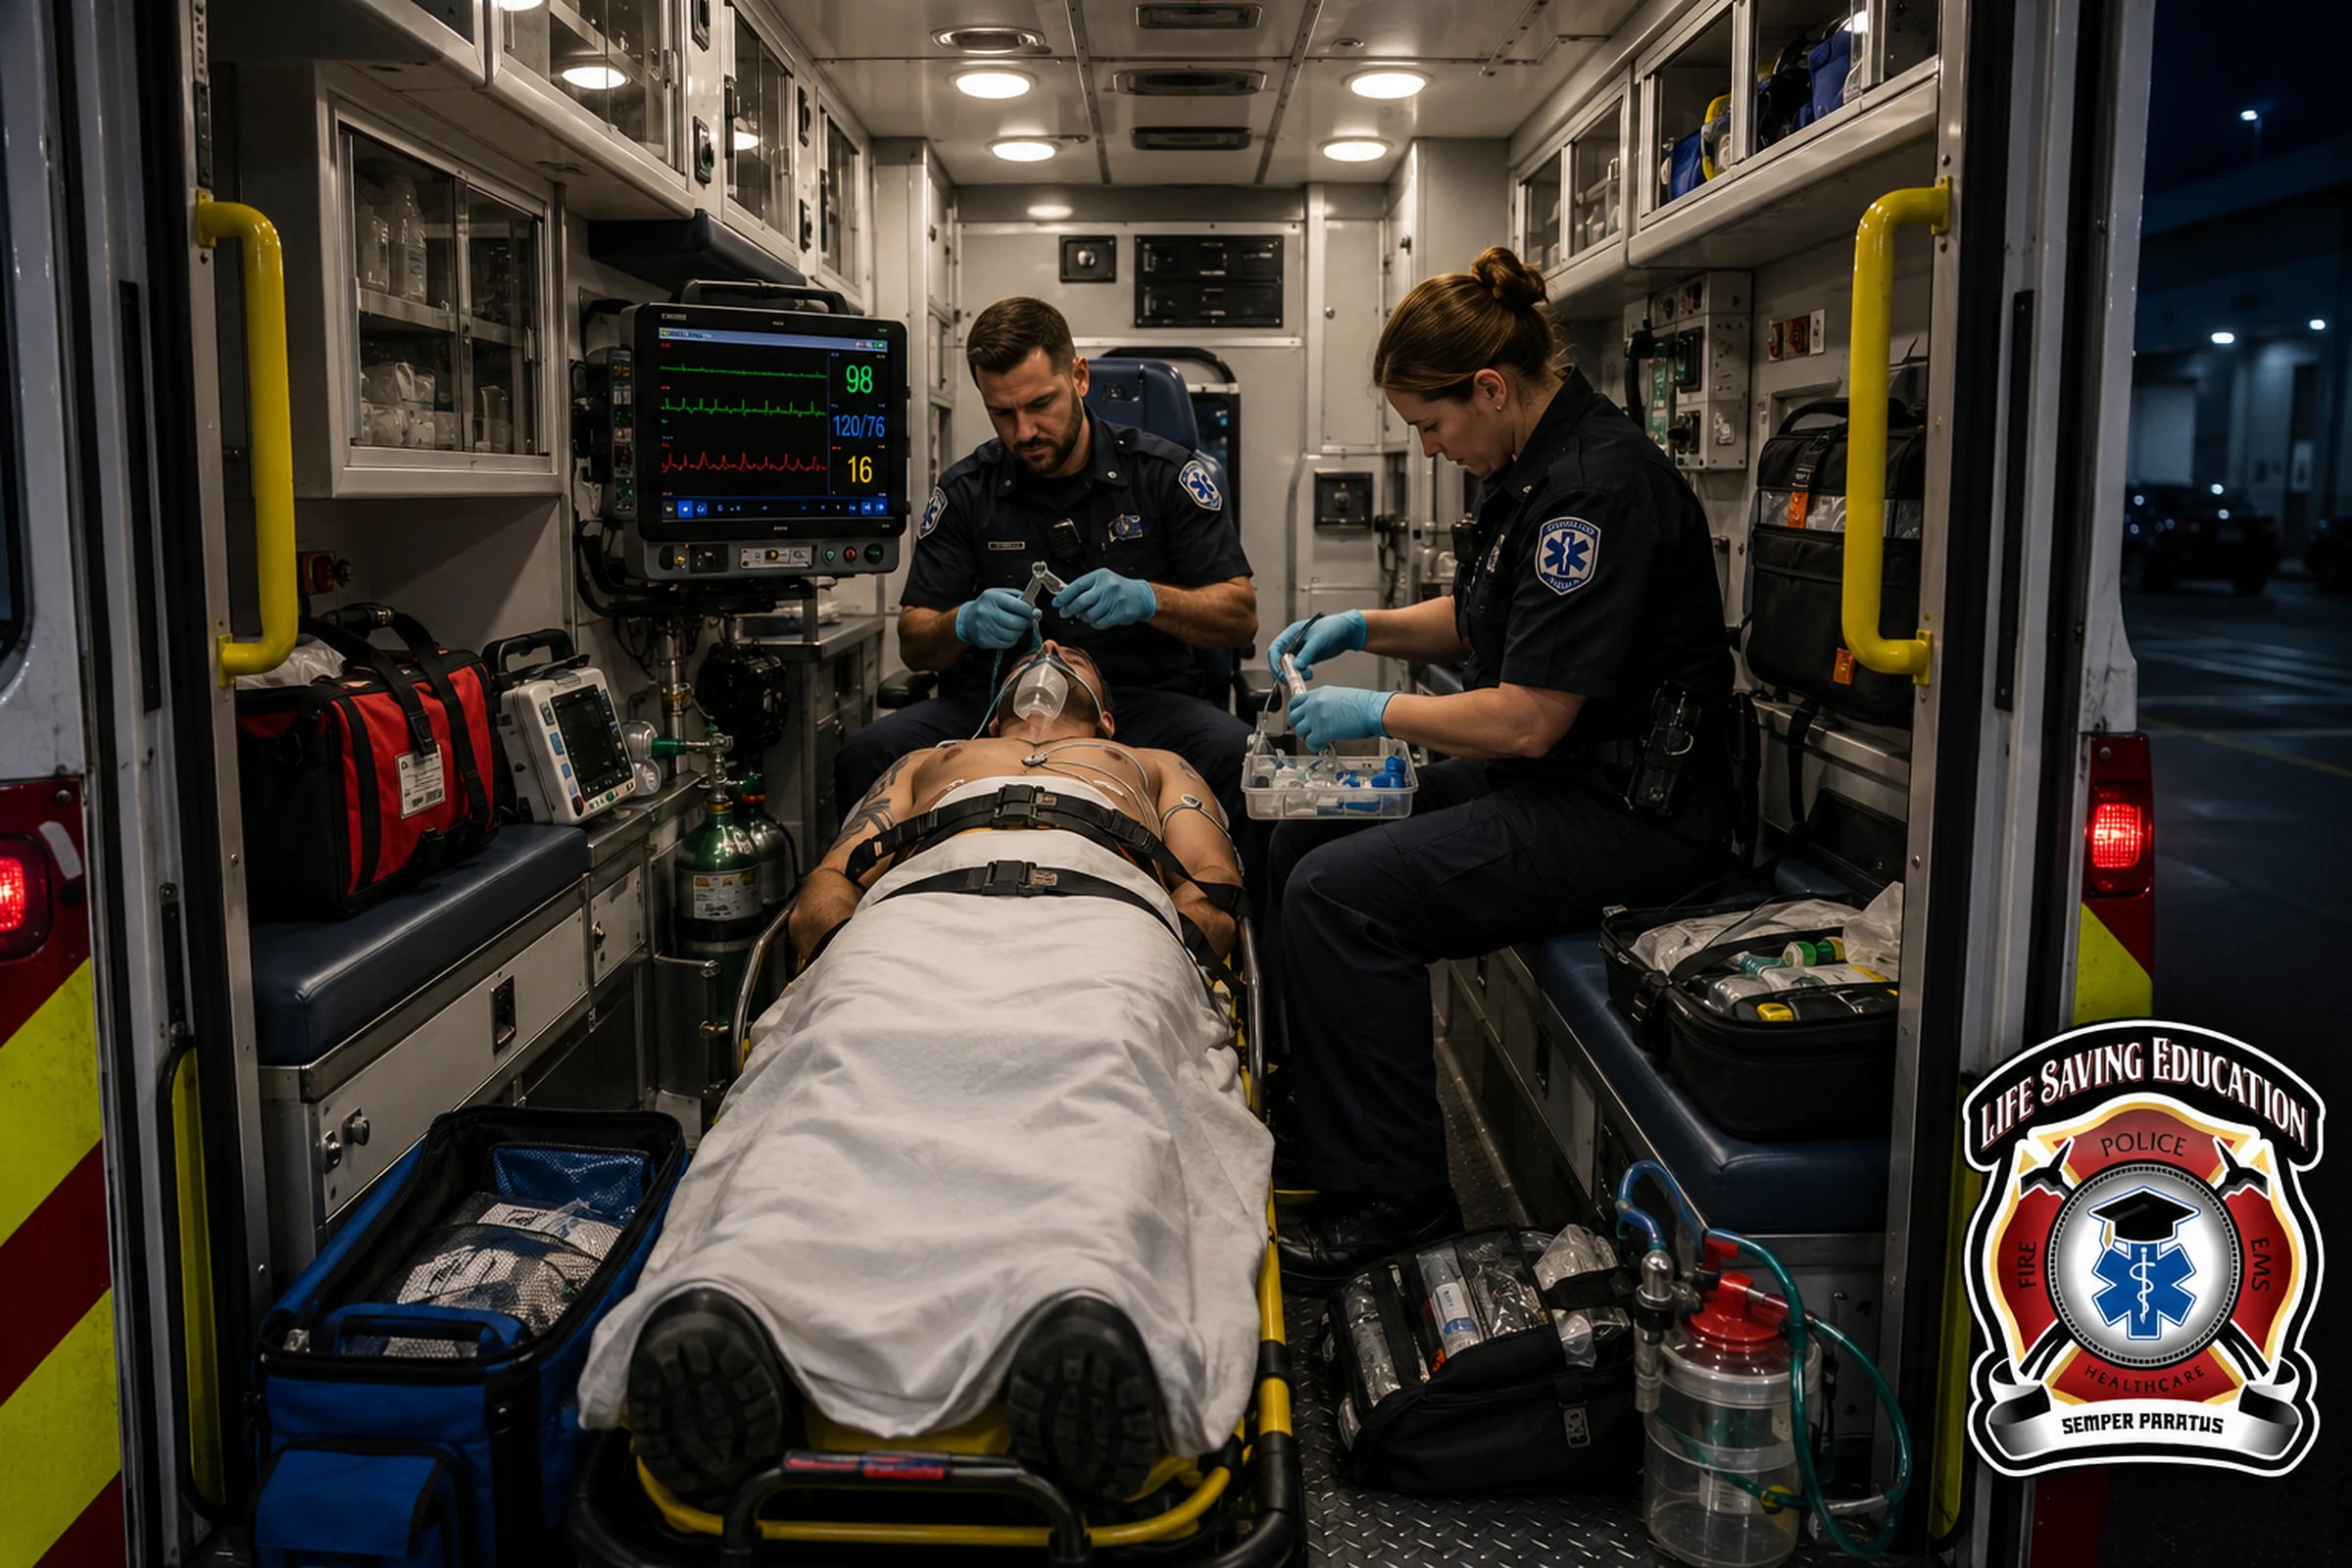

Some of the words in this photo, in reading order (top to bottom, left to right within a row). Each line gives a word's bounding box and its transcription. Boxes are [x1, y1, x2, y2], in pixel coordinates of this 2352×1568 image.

[846, 365, 873, 394] 98
[833, 414, 886, 439] 120/76
[848, 456, 873, 483] 16
